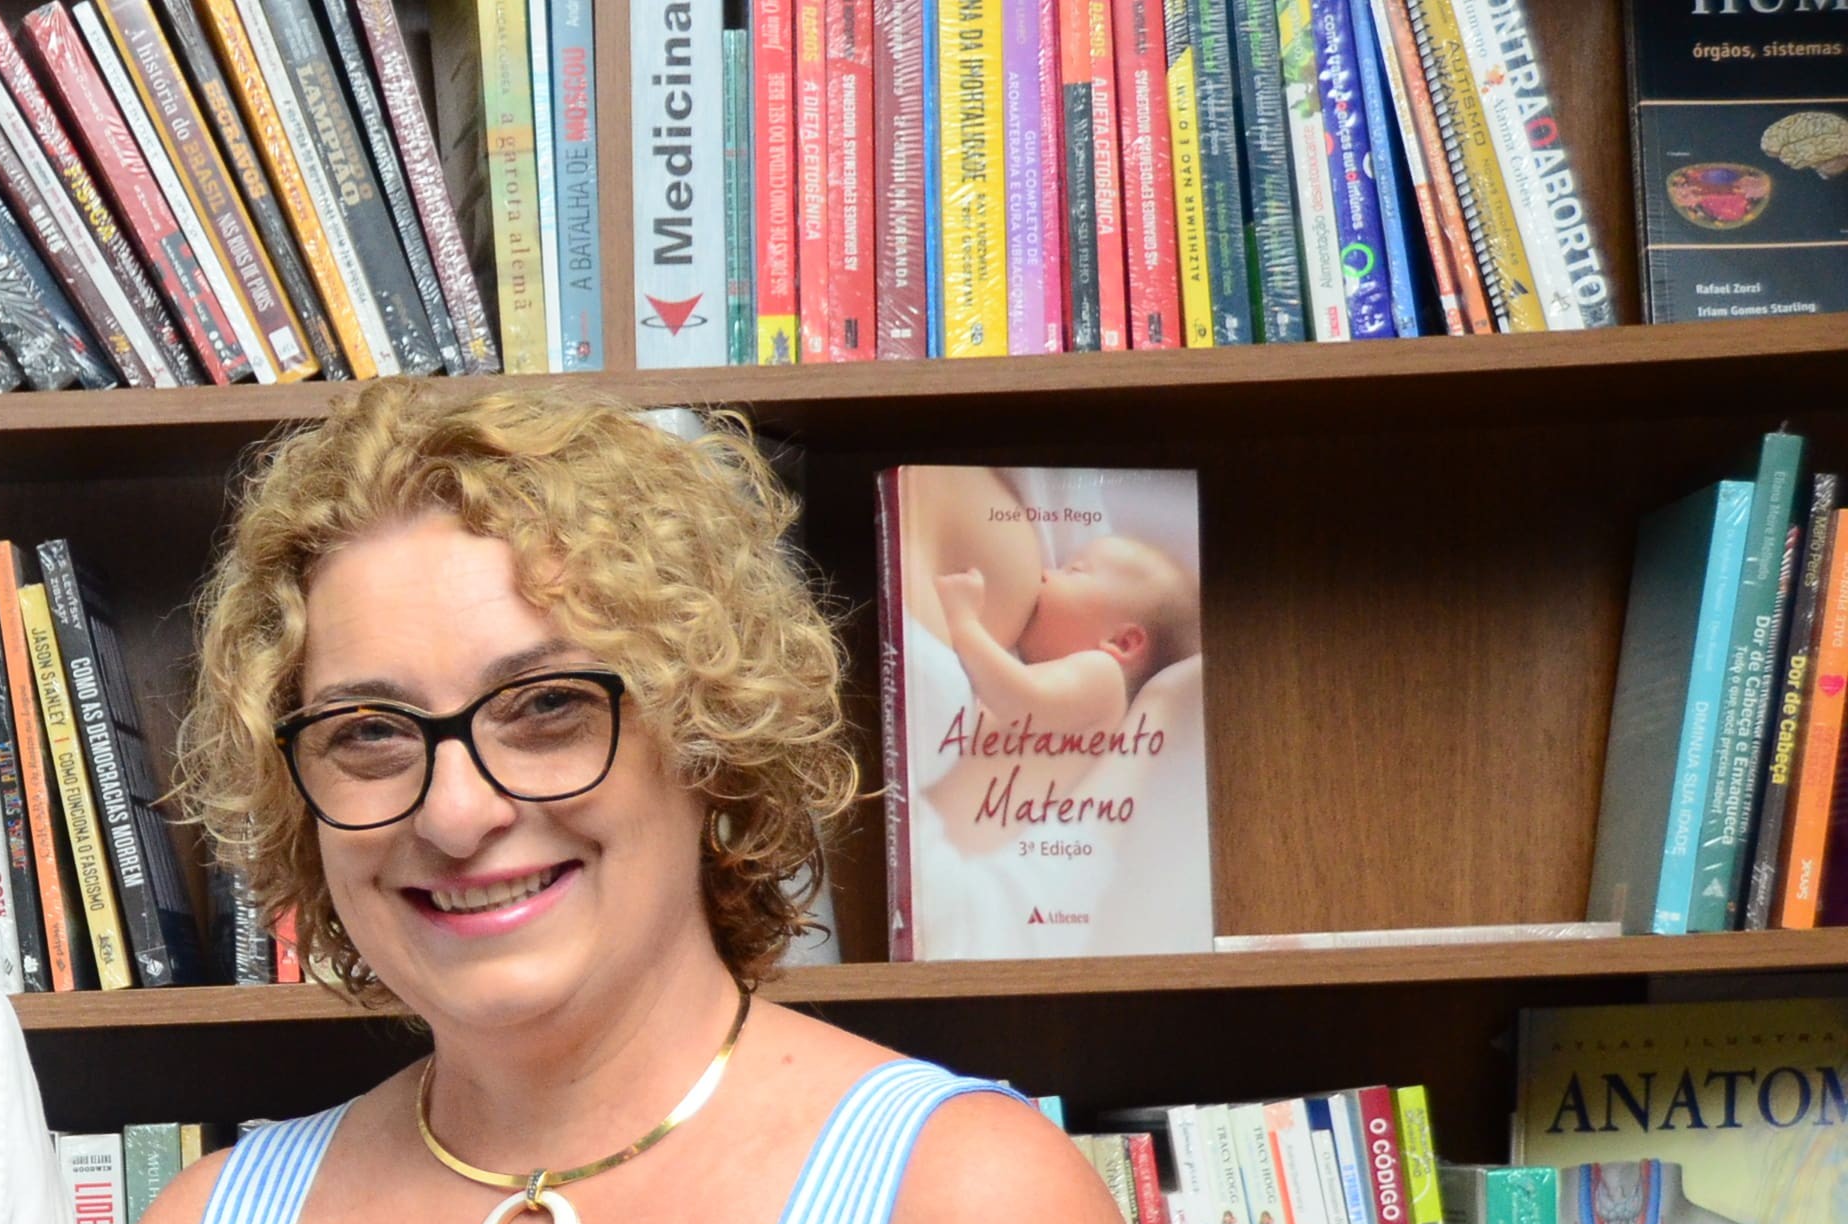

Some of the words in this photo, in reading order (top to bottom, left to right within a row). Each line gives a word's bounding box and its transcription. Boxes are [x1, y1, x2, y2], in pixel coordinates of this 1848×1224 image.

[960, 29, 985, 53] DA
[1692, 41, 1756, 60] órgãos,
[1763, 41, 1842, 58] sistemas
[563, 47, 589, 142] MOSCOU
[841, 74, 857, 136] MODERNAS
[1450, 40, 1485, 148] AUTISMO
[202, 80, 266, 201] ESCRAVOS
[295, 64, 361, 206] LAMPIÃO
[651, 1, 693, 266] Medicina
[959, 56, 987, 183] IMORTALIDADE
[566, 147, 589, 172] DE
[1024, 129, 1036, 165] GUIA
[842, 140, 857, 205] EPIDEMIAS
[567, 178, 590, 268] BATALHA
[1024, 169, 1038, 241] COMPLETO
[843, 208, 858, 253] GRANDES
[1320, 205, 1338, 289] Alimentação
[843, 256, 858, 271] AS
[1026, 246, 1038, 264] DE
[571, 275, 592, 290] A
[1695, 282, 1729, 294] Rafael
[1734, 282, 1760, 294] Zorzi
[1697, 305, 1727, 317] Iriam
[1731, 304, 1766, 317] Gomes
[1770, 302, 1816, 316] Starling
[987, 507, 1021, 523] José
[1026, 508, 1059, 523] Dias
[1063, 508, 1102, 524] Rego
[69, 656, 96, 702] COMO
[1786, 654, 1807, 689] Dor
[80, 702, 102, 722] AS
[1782, 690, 1801, 716] de
[938, 705, 1165, 759] Aleitamento
[1769, 717, 1798, 786] Cabeça
[84, 722, 128, 826] DEMOCRACIAS
[974, 765, 1135, 827] Materno
[111, 824, 144, 889] MORREM
[1018, 842, 1035, 856] 3ª
[1040, 841, 1092, 859] Edição
[1045, 910, 1090, 924] Atheneu
[1370, 1118, 1386, 1135] O
[1374, 1139, 1399, 1223] CÓDIGO
